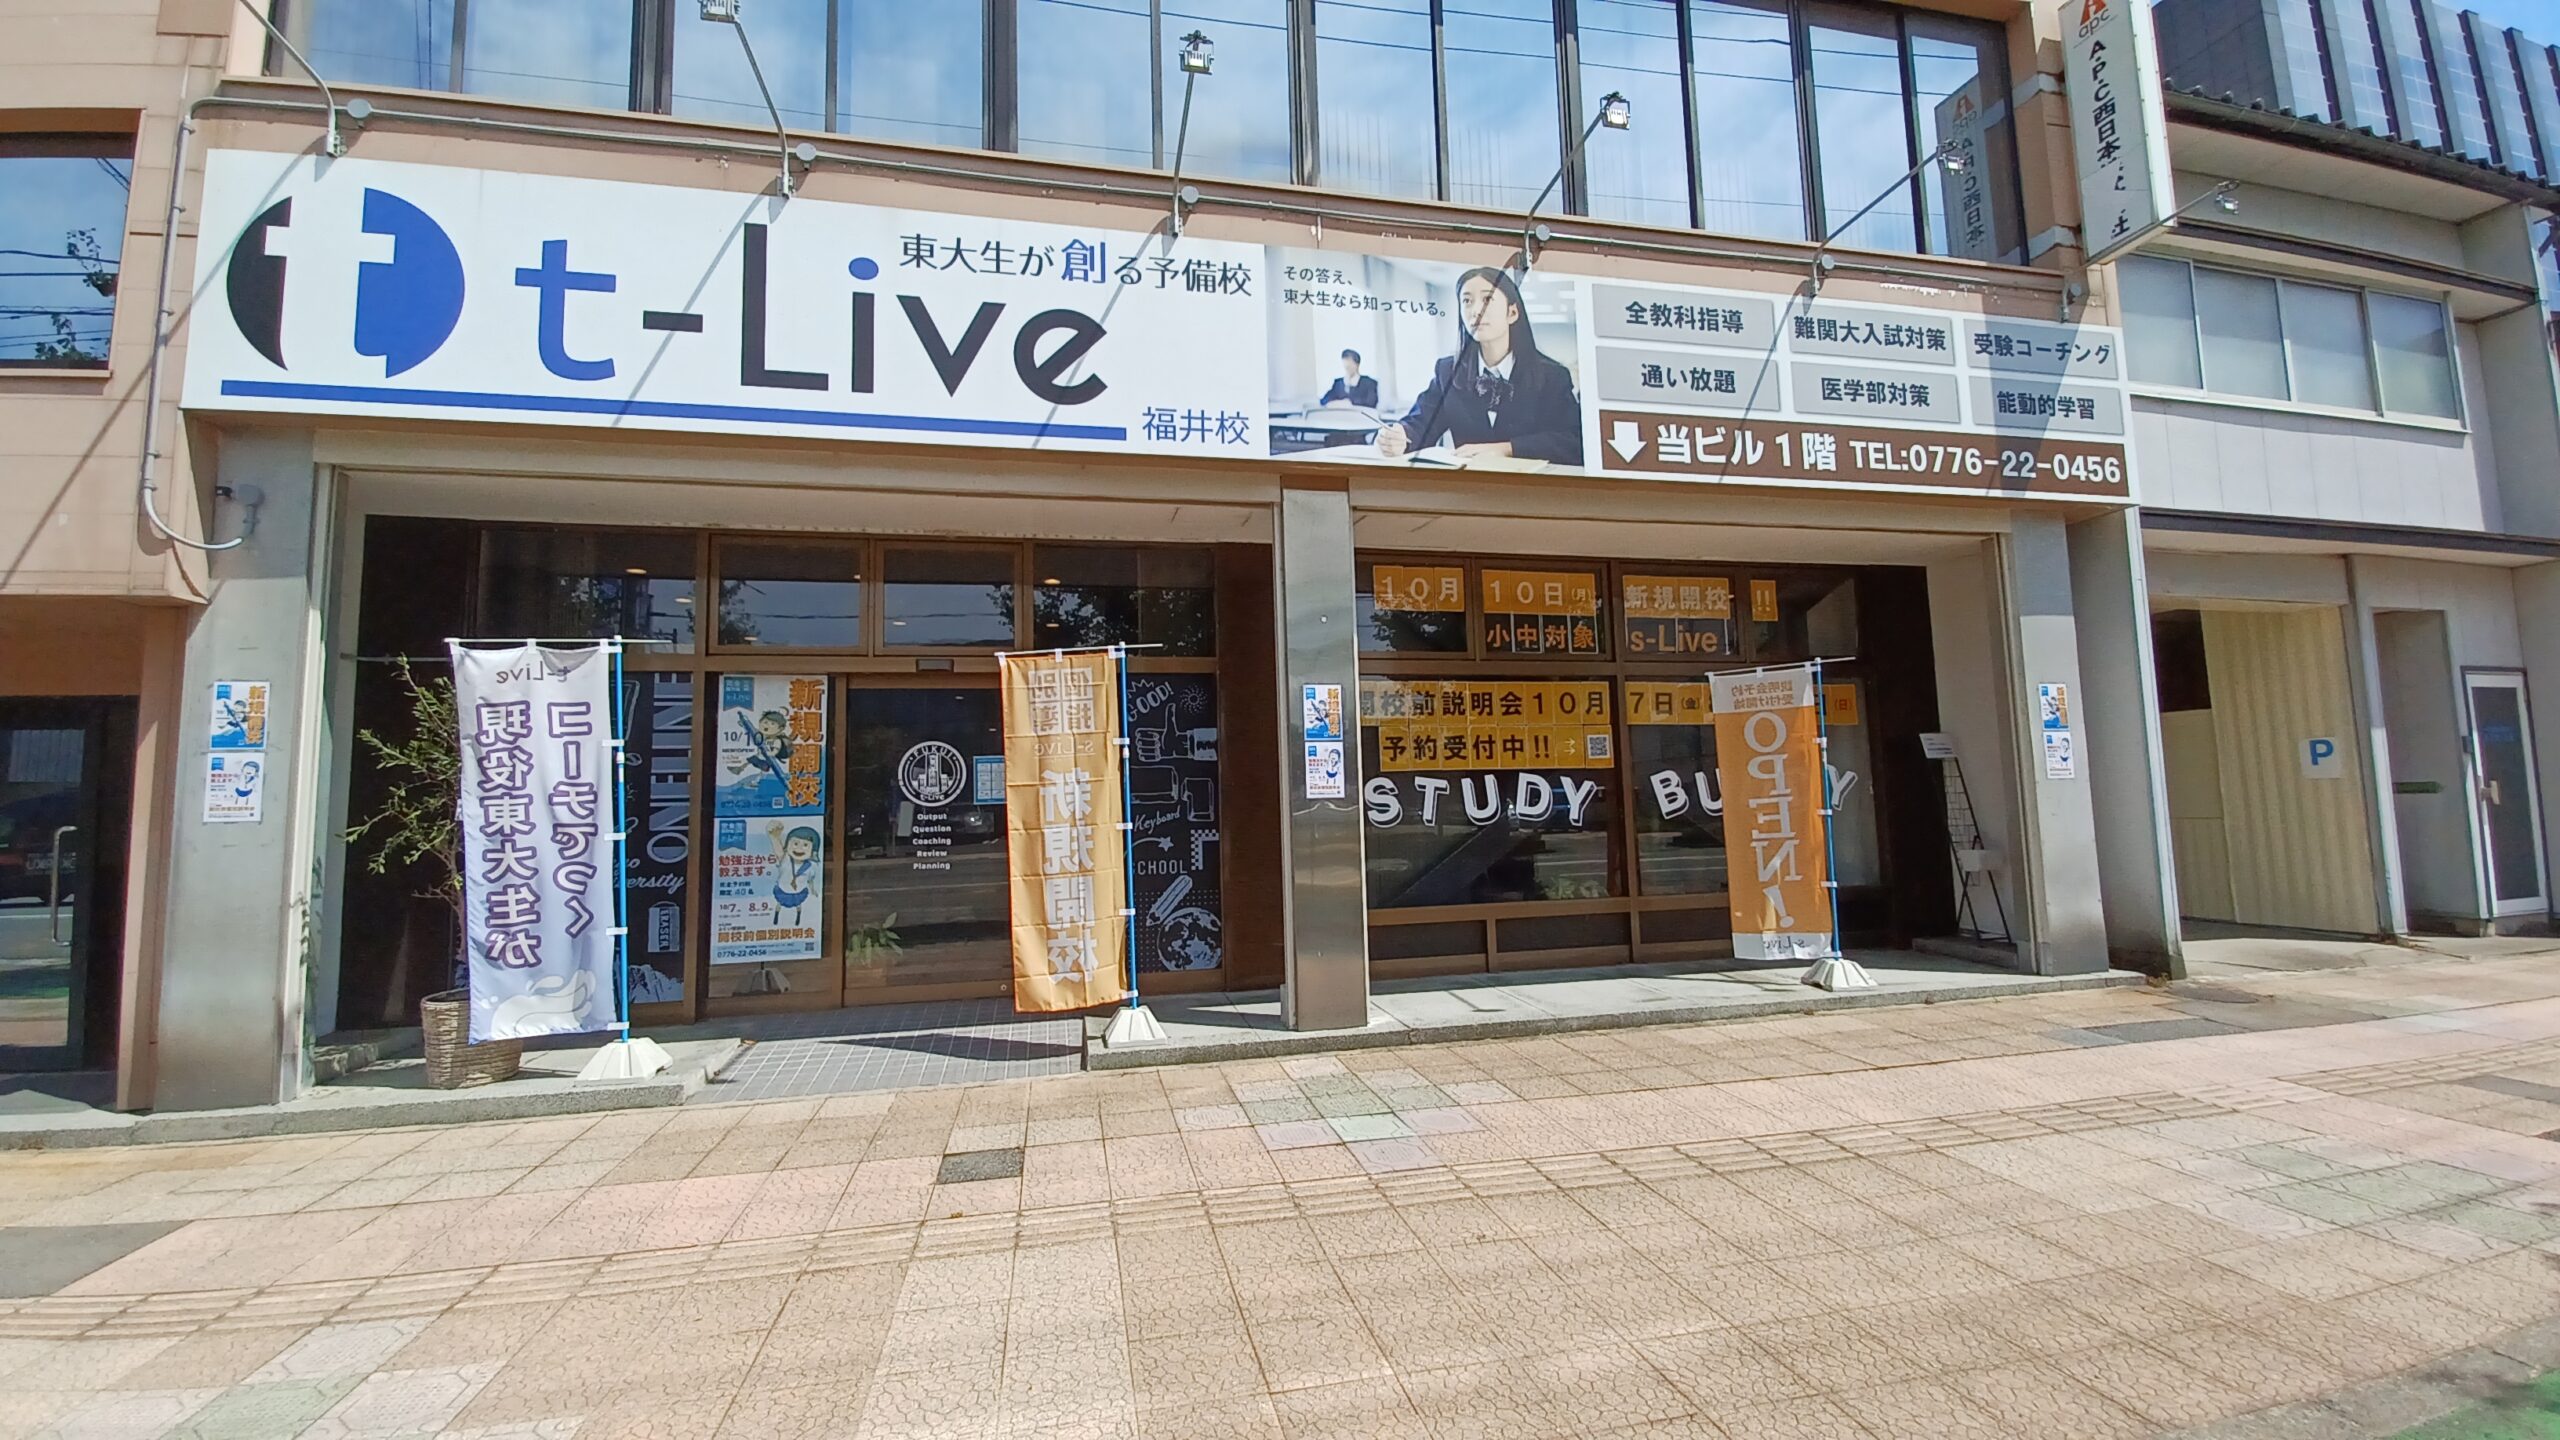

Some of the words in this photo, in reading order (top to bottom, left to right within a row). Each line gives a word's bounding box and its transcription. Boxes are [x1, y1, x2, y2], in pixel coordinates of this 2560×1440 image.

[2078, 8, 2112, 38] apc
[899, 233, 1254, 297] 東大生が創る予備校
[1283, 265, 1353, 286] その答え、
[515, 222, 1109, 406] t-Live
[1283, 288, 1447, 318] 東大生なら知っている。
[1625, 300, 1745, 334] 全教科指導
[1793, 315, 1947, 352] 難関大入試対策
[1973, 332, 2112, 365] 受験コーチング
[1640, 362, 1737, 394] 通い放題
[1821, 375, 1932, 408] 医学部対策
[1996, 391, 2096, 420] 能動的学習
[1141, 406, 1250, 446] 福井校
[1656, 423, 1838, 473] 当ビル1階
[1849, 439, 2122, 484] TEL:0776-22-0456
[1380, 575, 1459, 604] 10月
[1624, 584, 1729, 611] 新規開校
[1486, 622, 1595, 650] 小中対象
[1631, 624, 1719, 652] s-Live
[788, 678, 825, 808] 新規開校
[1382, 735, 1550, 762] 予約受付中!!
[2308, 738, 2335, 767] P
[1363, 771, 1598, 828] STUDY
[1650, 765, 1858, 821] BUY
[912, 825, 952, 833] Question
[917, 813, 947, 821] Output
[1133, 804, 1181, 835] Keyboard
[912, 837, 952, 845] Coaching
[913, 861, 951, 870] Planning
[1132, 859, 1188, 876] CHOOL
